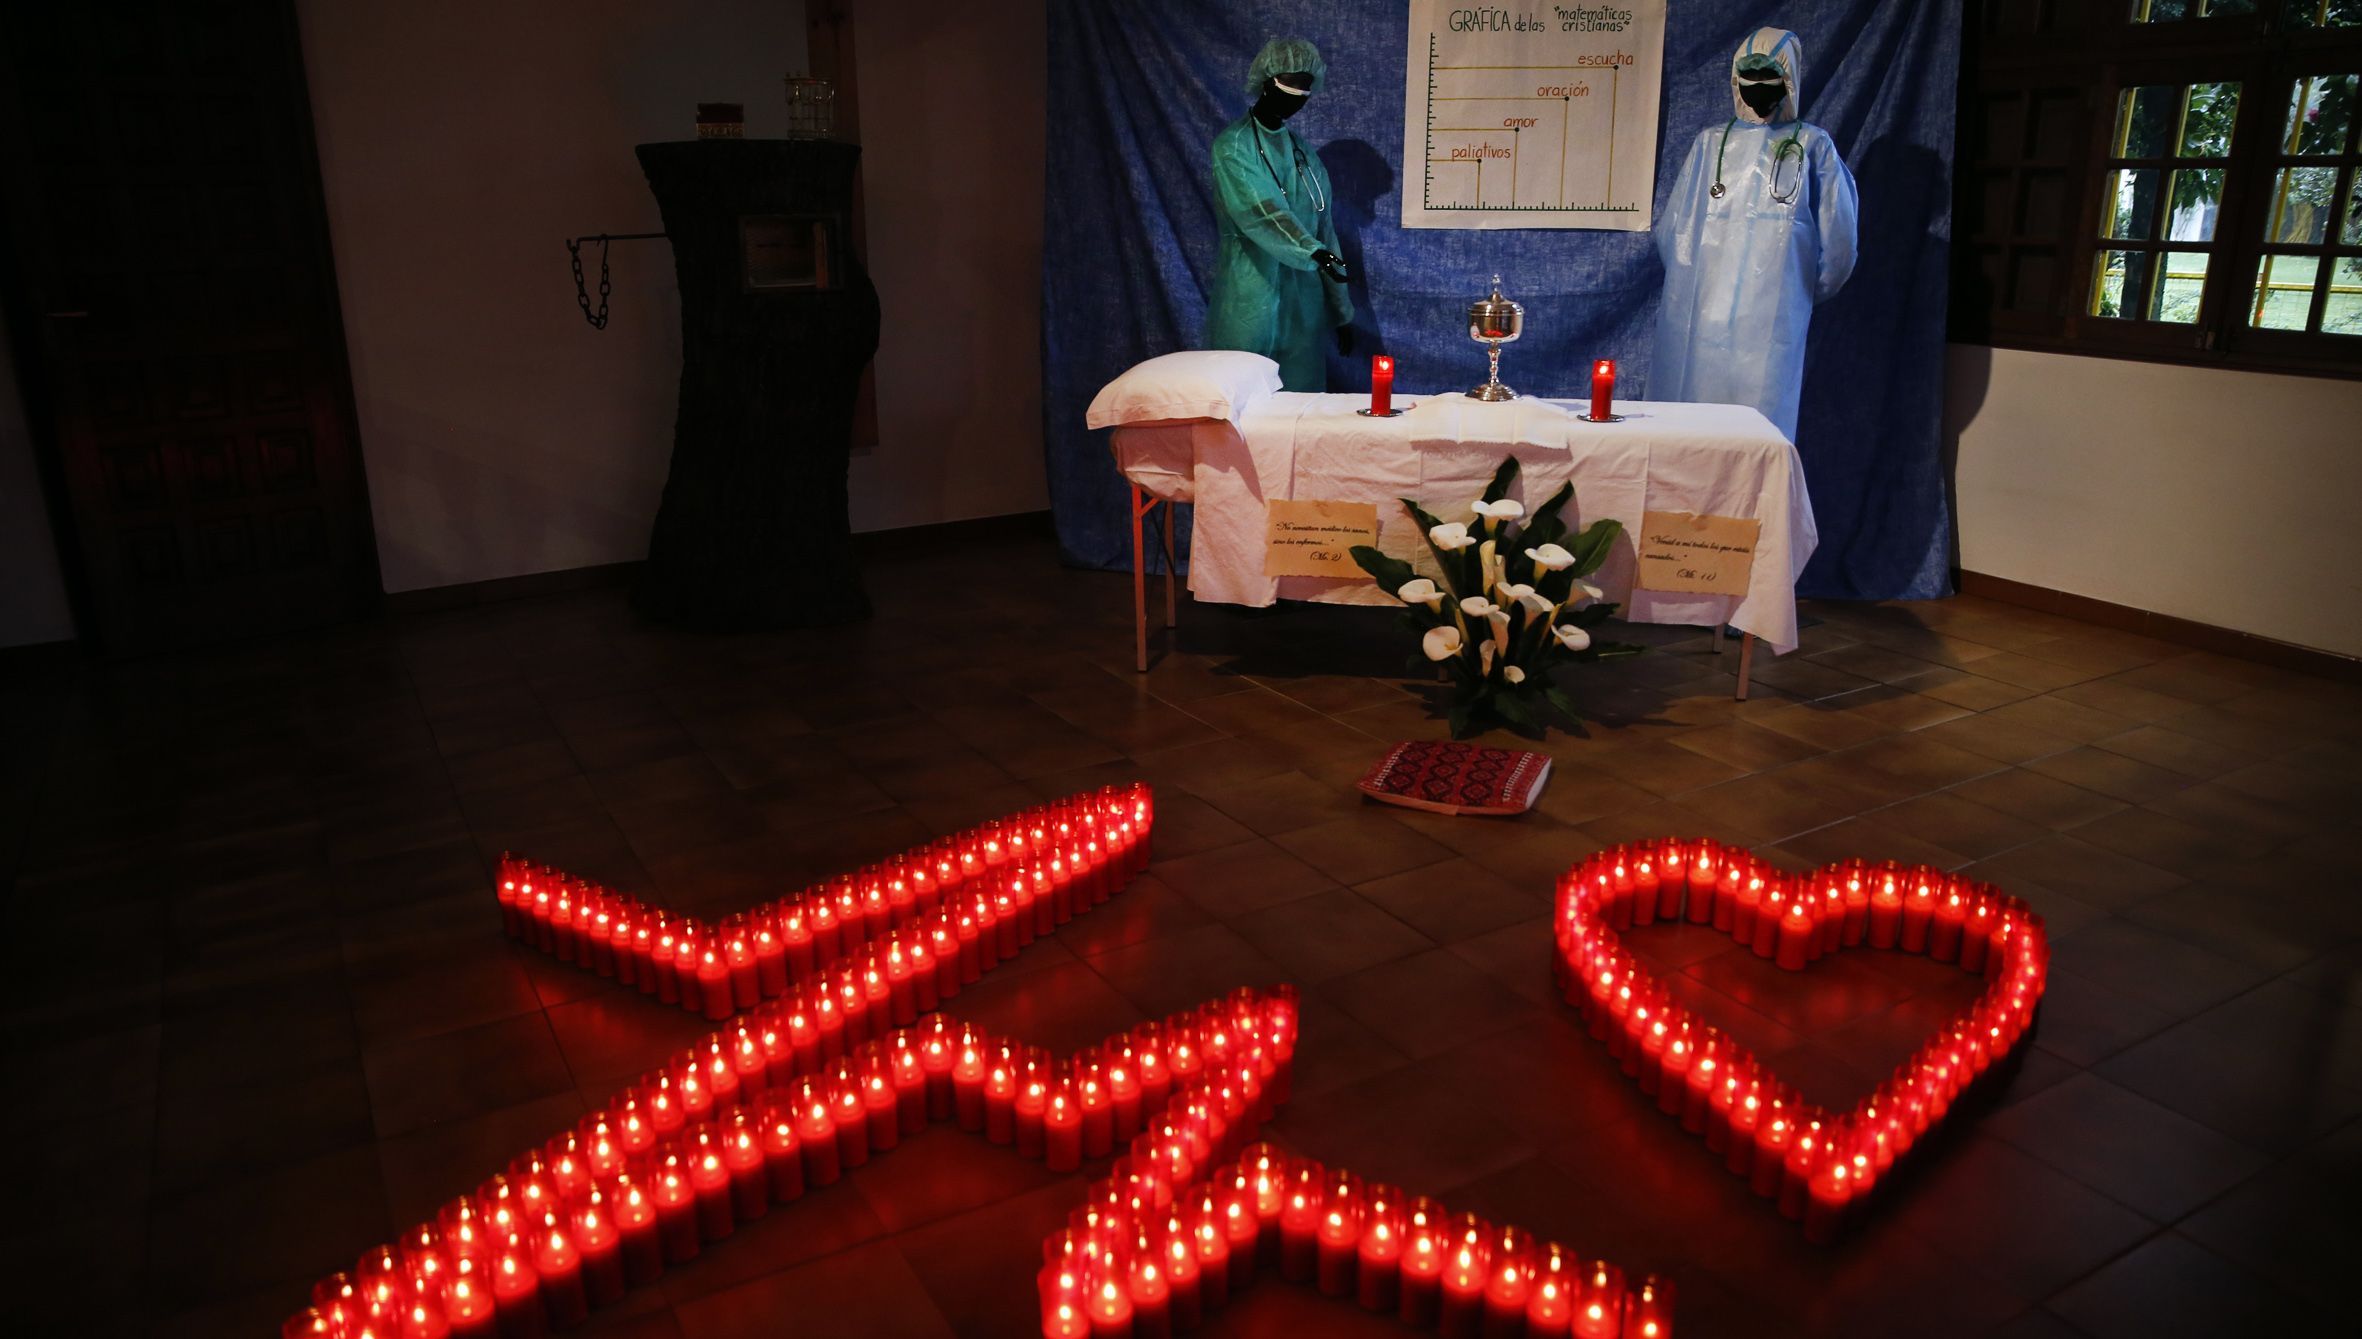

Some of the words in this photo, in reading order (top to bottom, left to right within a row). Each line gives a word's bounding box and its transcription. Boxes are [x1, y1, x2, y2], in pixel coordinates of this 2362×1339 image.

[1449, 6, 1511, 32] GRÁFICA
[1514, 14, 1526, 32] de
[1529, 13, 1545, 32] las
[1578, 50, 1633, 66] escucha
[1537, 81, 1589, 97] oración
[1503, 116, 1539, 128] amor
[1451, 141, 1511, 162] paliativos
